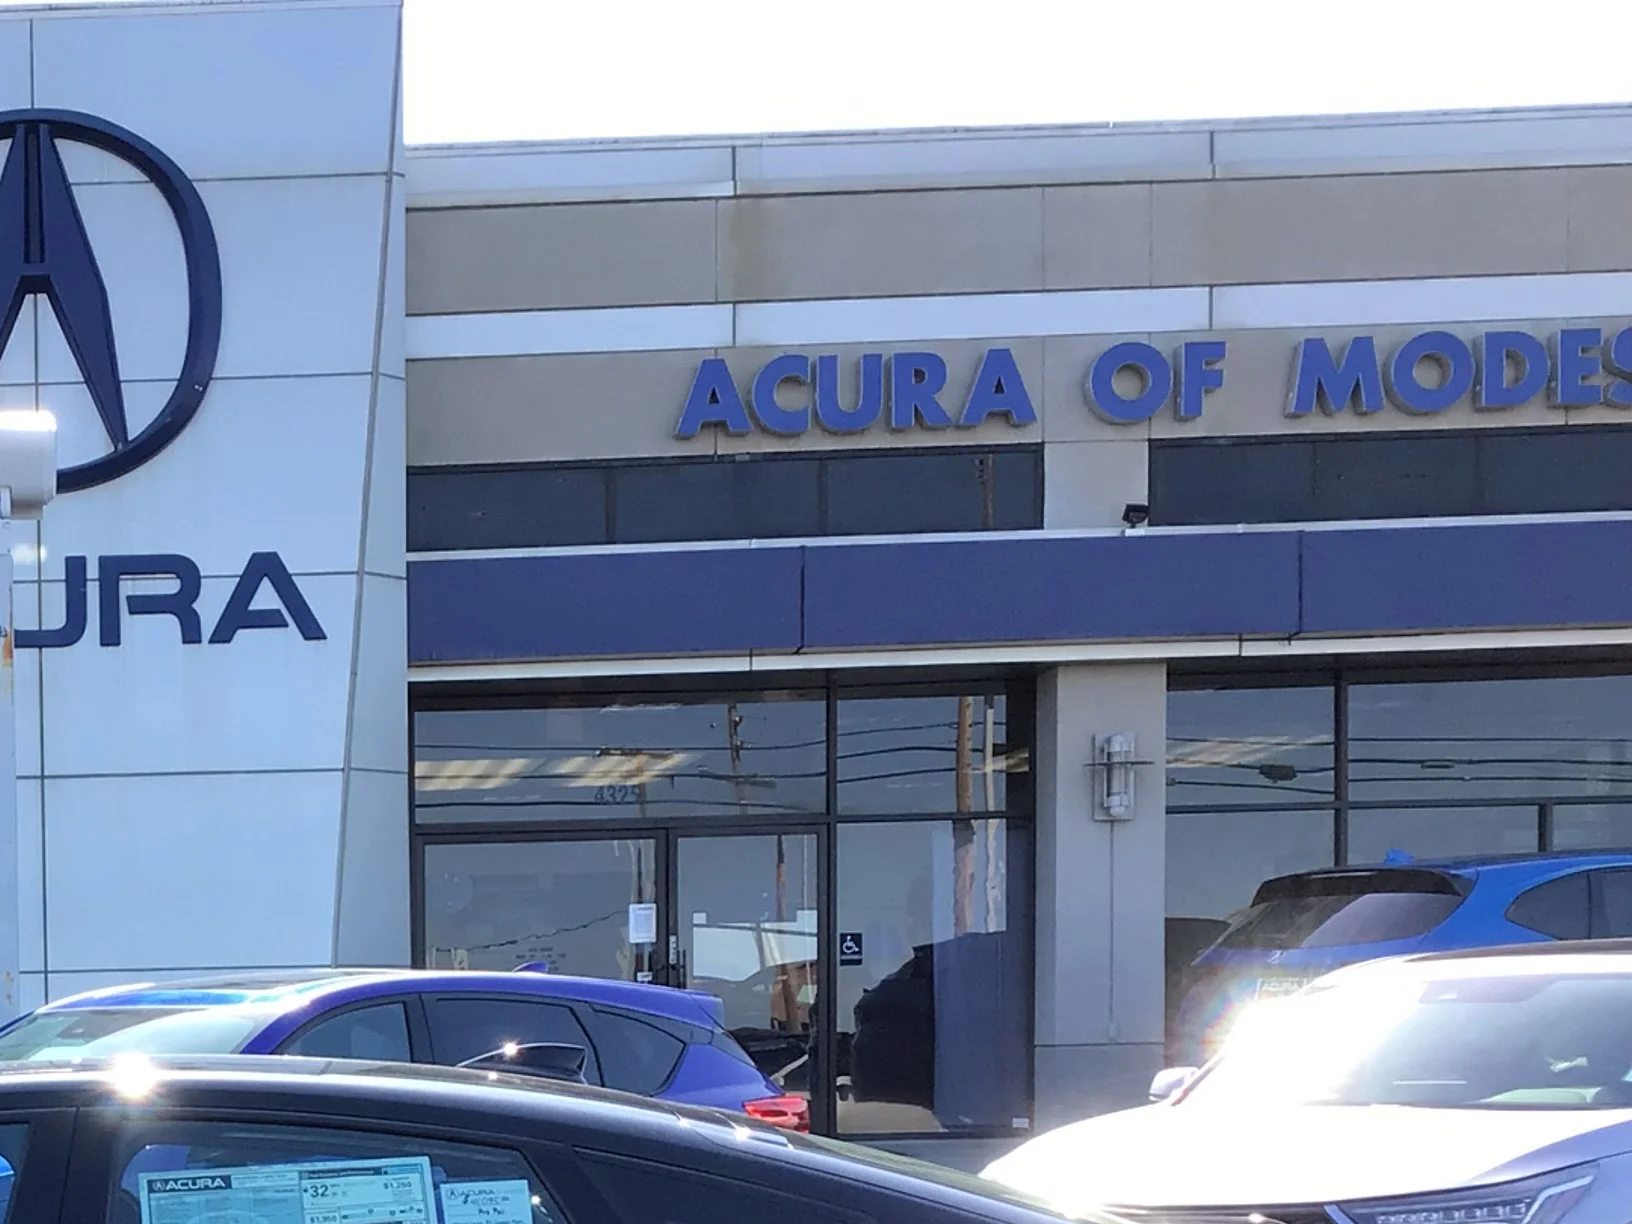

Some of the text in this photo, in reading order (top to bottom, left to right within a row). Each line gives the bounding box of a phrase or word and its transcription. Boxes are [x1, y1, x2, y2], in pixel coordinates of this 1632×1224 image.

[675, 347, 1036, 439] ACURA
[1085, 340, 1228, 424] OF
[166, 1178, 226, 1191] ACURA
[310, 1184, 329, 1198] 32
